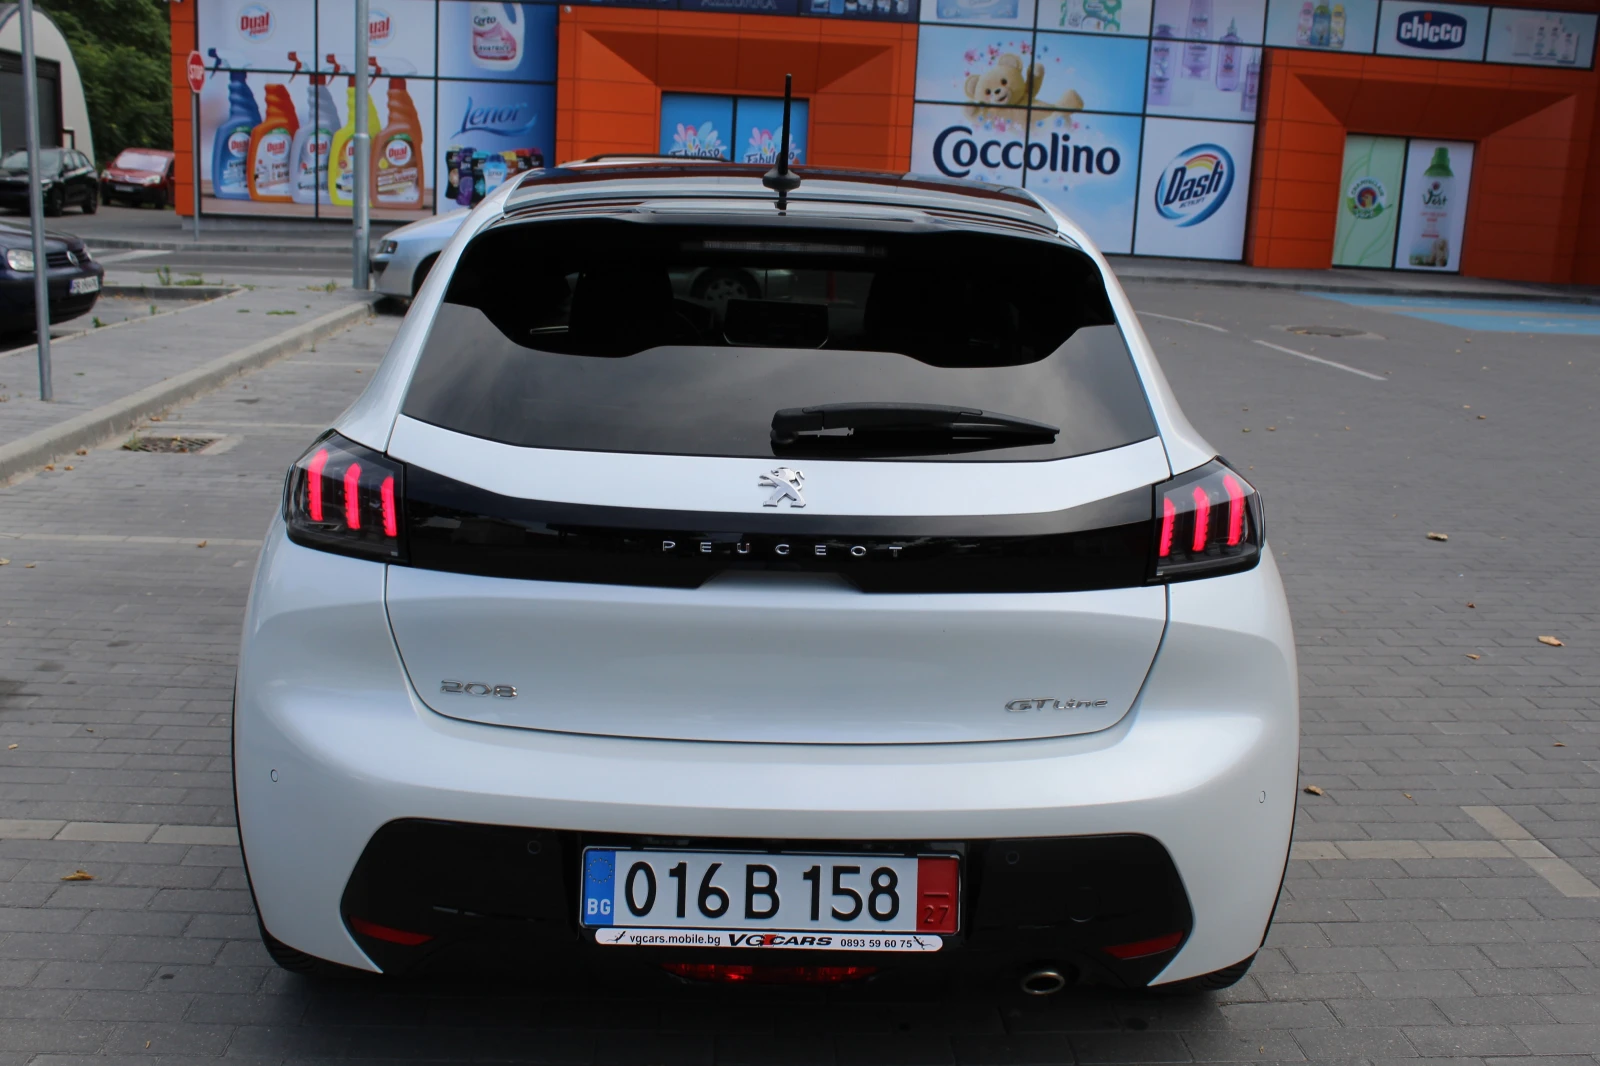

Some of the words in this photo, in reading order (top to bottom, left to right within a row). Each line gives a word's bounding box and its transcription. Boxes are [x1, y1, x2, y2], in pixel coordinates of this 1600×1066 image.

[241, 12, 270, 31] Dual
[369, 17, 390, 34] ual
[1401, 12, 1462, 43] chicco
[189, 64, 204, 80] STOP
[460, 96, 528, 133] Lenor
[932, 125, 1121, 178] Coccolino
[1163, 160, 1224, 206] Dash
[662, 540, 903, 558] PEUGEOT
[440, 679, 519, 699] 208
[625, 860, 731, 919] 016
[744, 863, 781, 920] B
[802, 865, 900, 922] 158
[587, 898, 611, 915] BG
[923, 904, 949, 925] 27
[629, 933, 721, 946] vgcars.mobile.bg
[840, 938, 866, 948] 0893
[868, 939, 882, 948] 59
[884, 939, 897, 948] 60
[899, 939, 913, 949] 75
